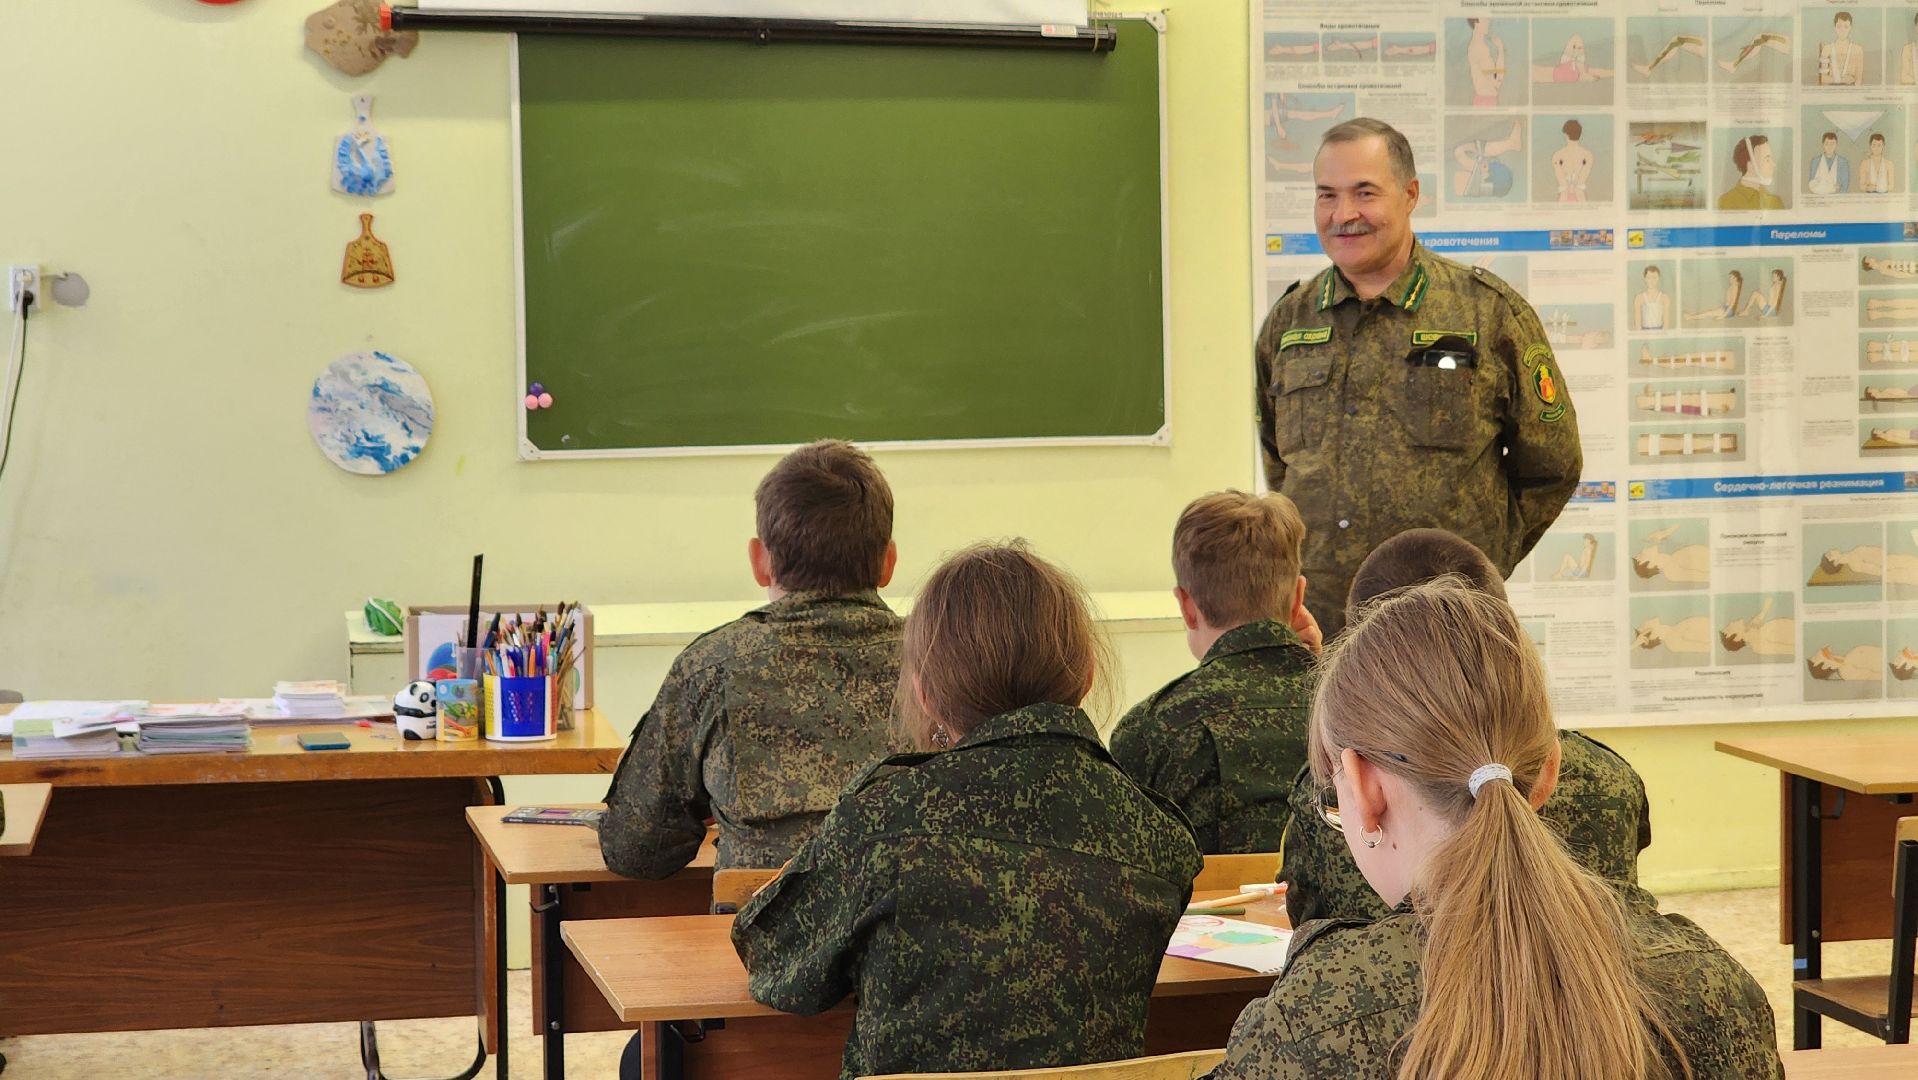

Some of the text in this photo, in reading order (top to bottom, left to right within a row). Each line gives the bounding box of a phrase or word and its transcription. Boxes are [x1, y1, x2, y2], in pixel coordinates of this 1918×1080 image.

[1770, 230, 1827, 241] Переломы
[1424, 237, 1500, 249] кровотечения
[1713, 479, 1885, 494] Сердечно-легочная реанимация
